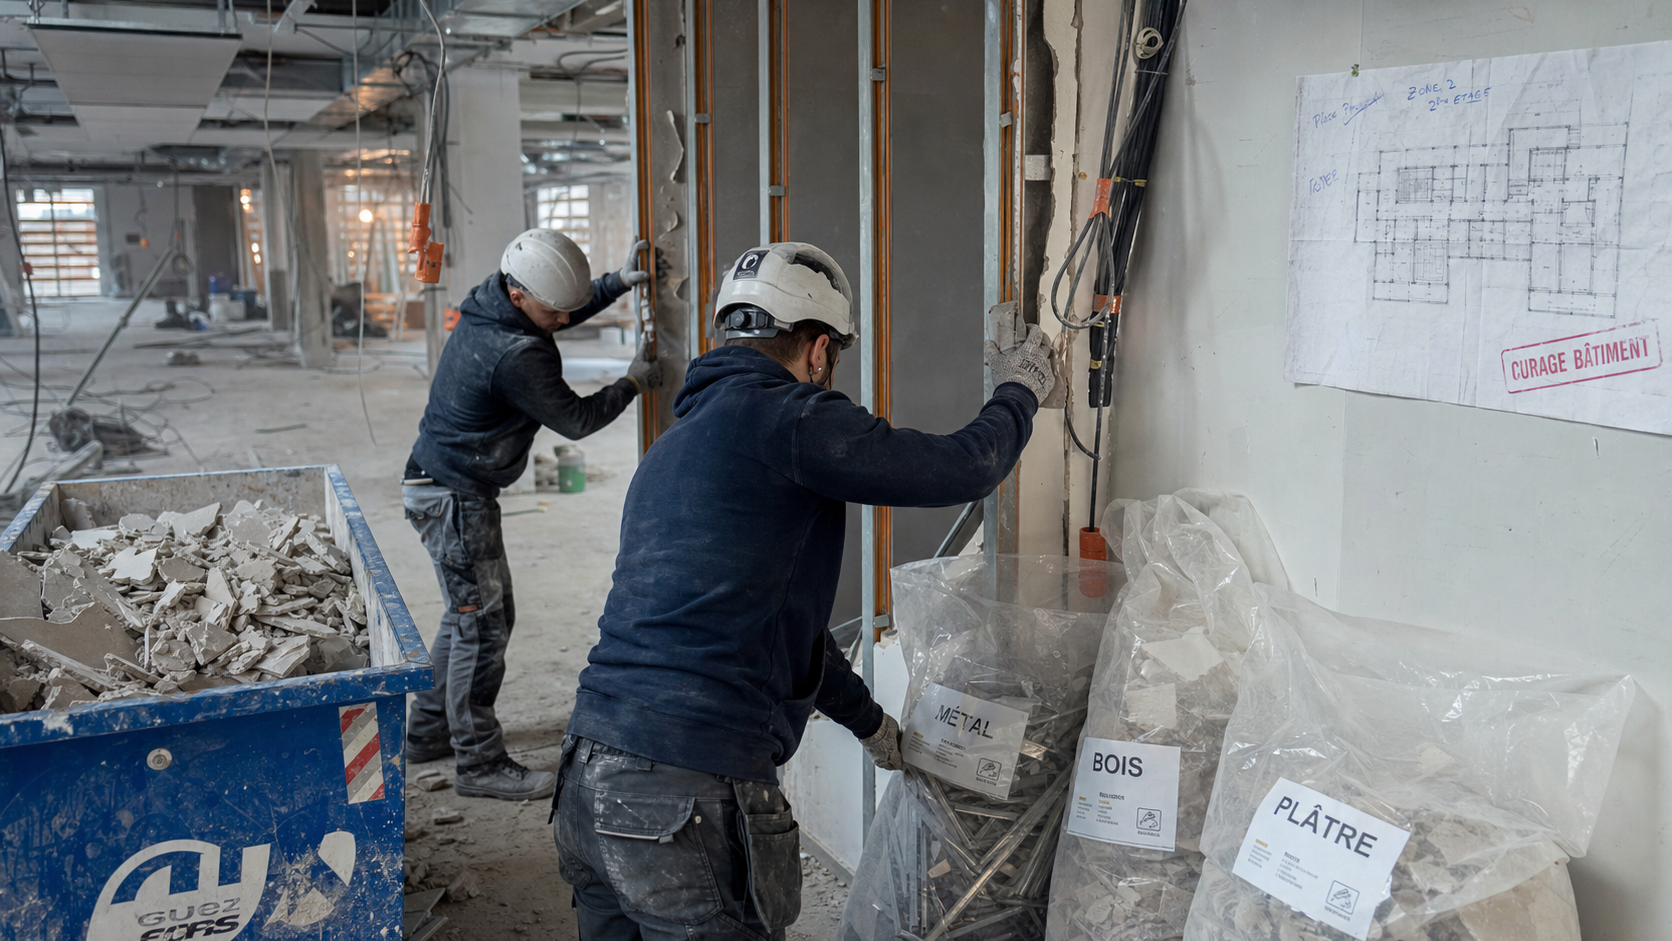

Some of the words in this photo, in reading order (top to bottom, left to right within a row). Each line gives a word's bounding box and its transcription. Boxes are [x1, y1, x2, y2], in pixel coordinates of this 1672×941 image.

[1407, 84, 1441, 101] ZONE
[1446, 79, 1456, 90] 2
[1511, 352, 1568, 381] CURAGE
[1573, 335, 1650, 370] BÂTIMENT
[934, 704, 994, 740] MÉTAL
[1092, 751, 1143, 778] BOIS
[1273, 795, 1378, 859] PLÂTRE
